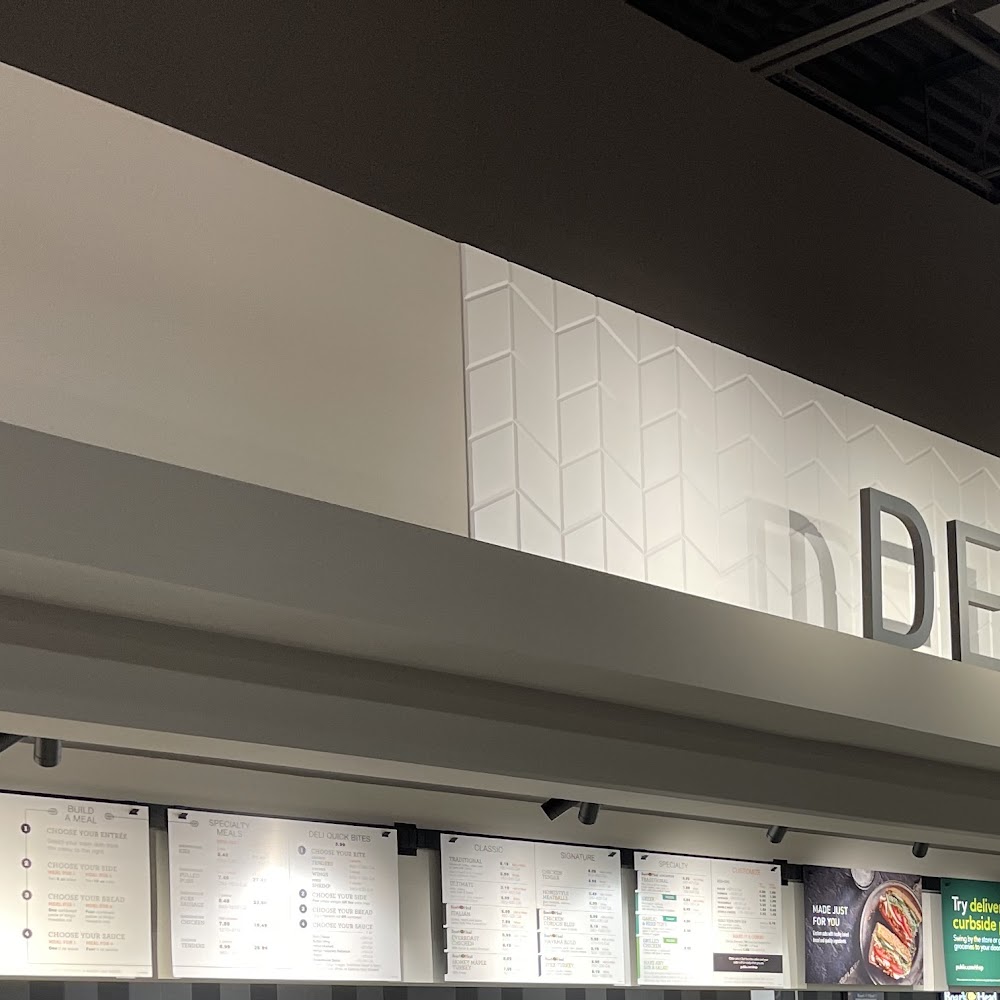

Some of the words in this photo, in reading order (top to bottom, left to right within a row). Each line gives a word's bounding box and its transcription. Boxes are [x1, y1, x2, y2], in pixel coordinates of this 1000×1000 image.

[67, 805, 94, 814] BUILD
[72, 816, 96, 824] MEAL
[209, 819, 250, 829] SPECIALTY
[47, 828, 77, 836] CHOOSE
[79, 829, 99, 837] YOUR
[217, 829, 243, 838] MEALS
[327, 832, 349, 840] QUICK
[311, 848, 335, 856] CHOOSE
[474, 844, 503, 853] CLASSIC
[561, 852, 596, 861] SIGNATURE
[48, 862, 78, 870] CHOOSE
[659, 861, 688, 869] SPECIALTY
[48, 893, 79, 901] CHOOSE
[102, 895, 125, 903] BREAD
[813, 905, 831, 914] MADE
[833, 906, 848, 915] JUST
[952, 896, 967, 916] Try
[813, 917, 826, 926] FOR
[827, 918, 840, 926] YOU
[953, 915, 996, 931] curbside
[953, 934, 967, 943] Swing
